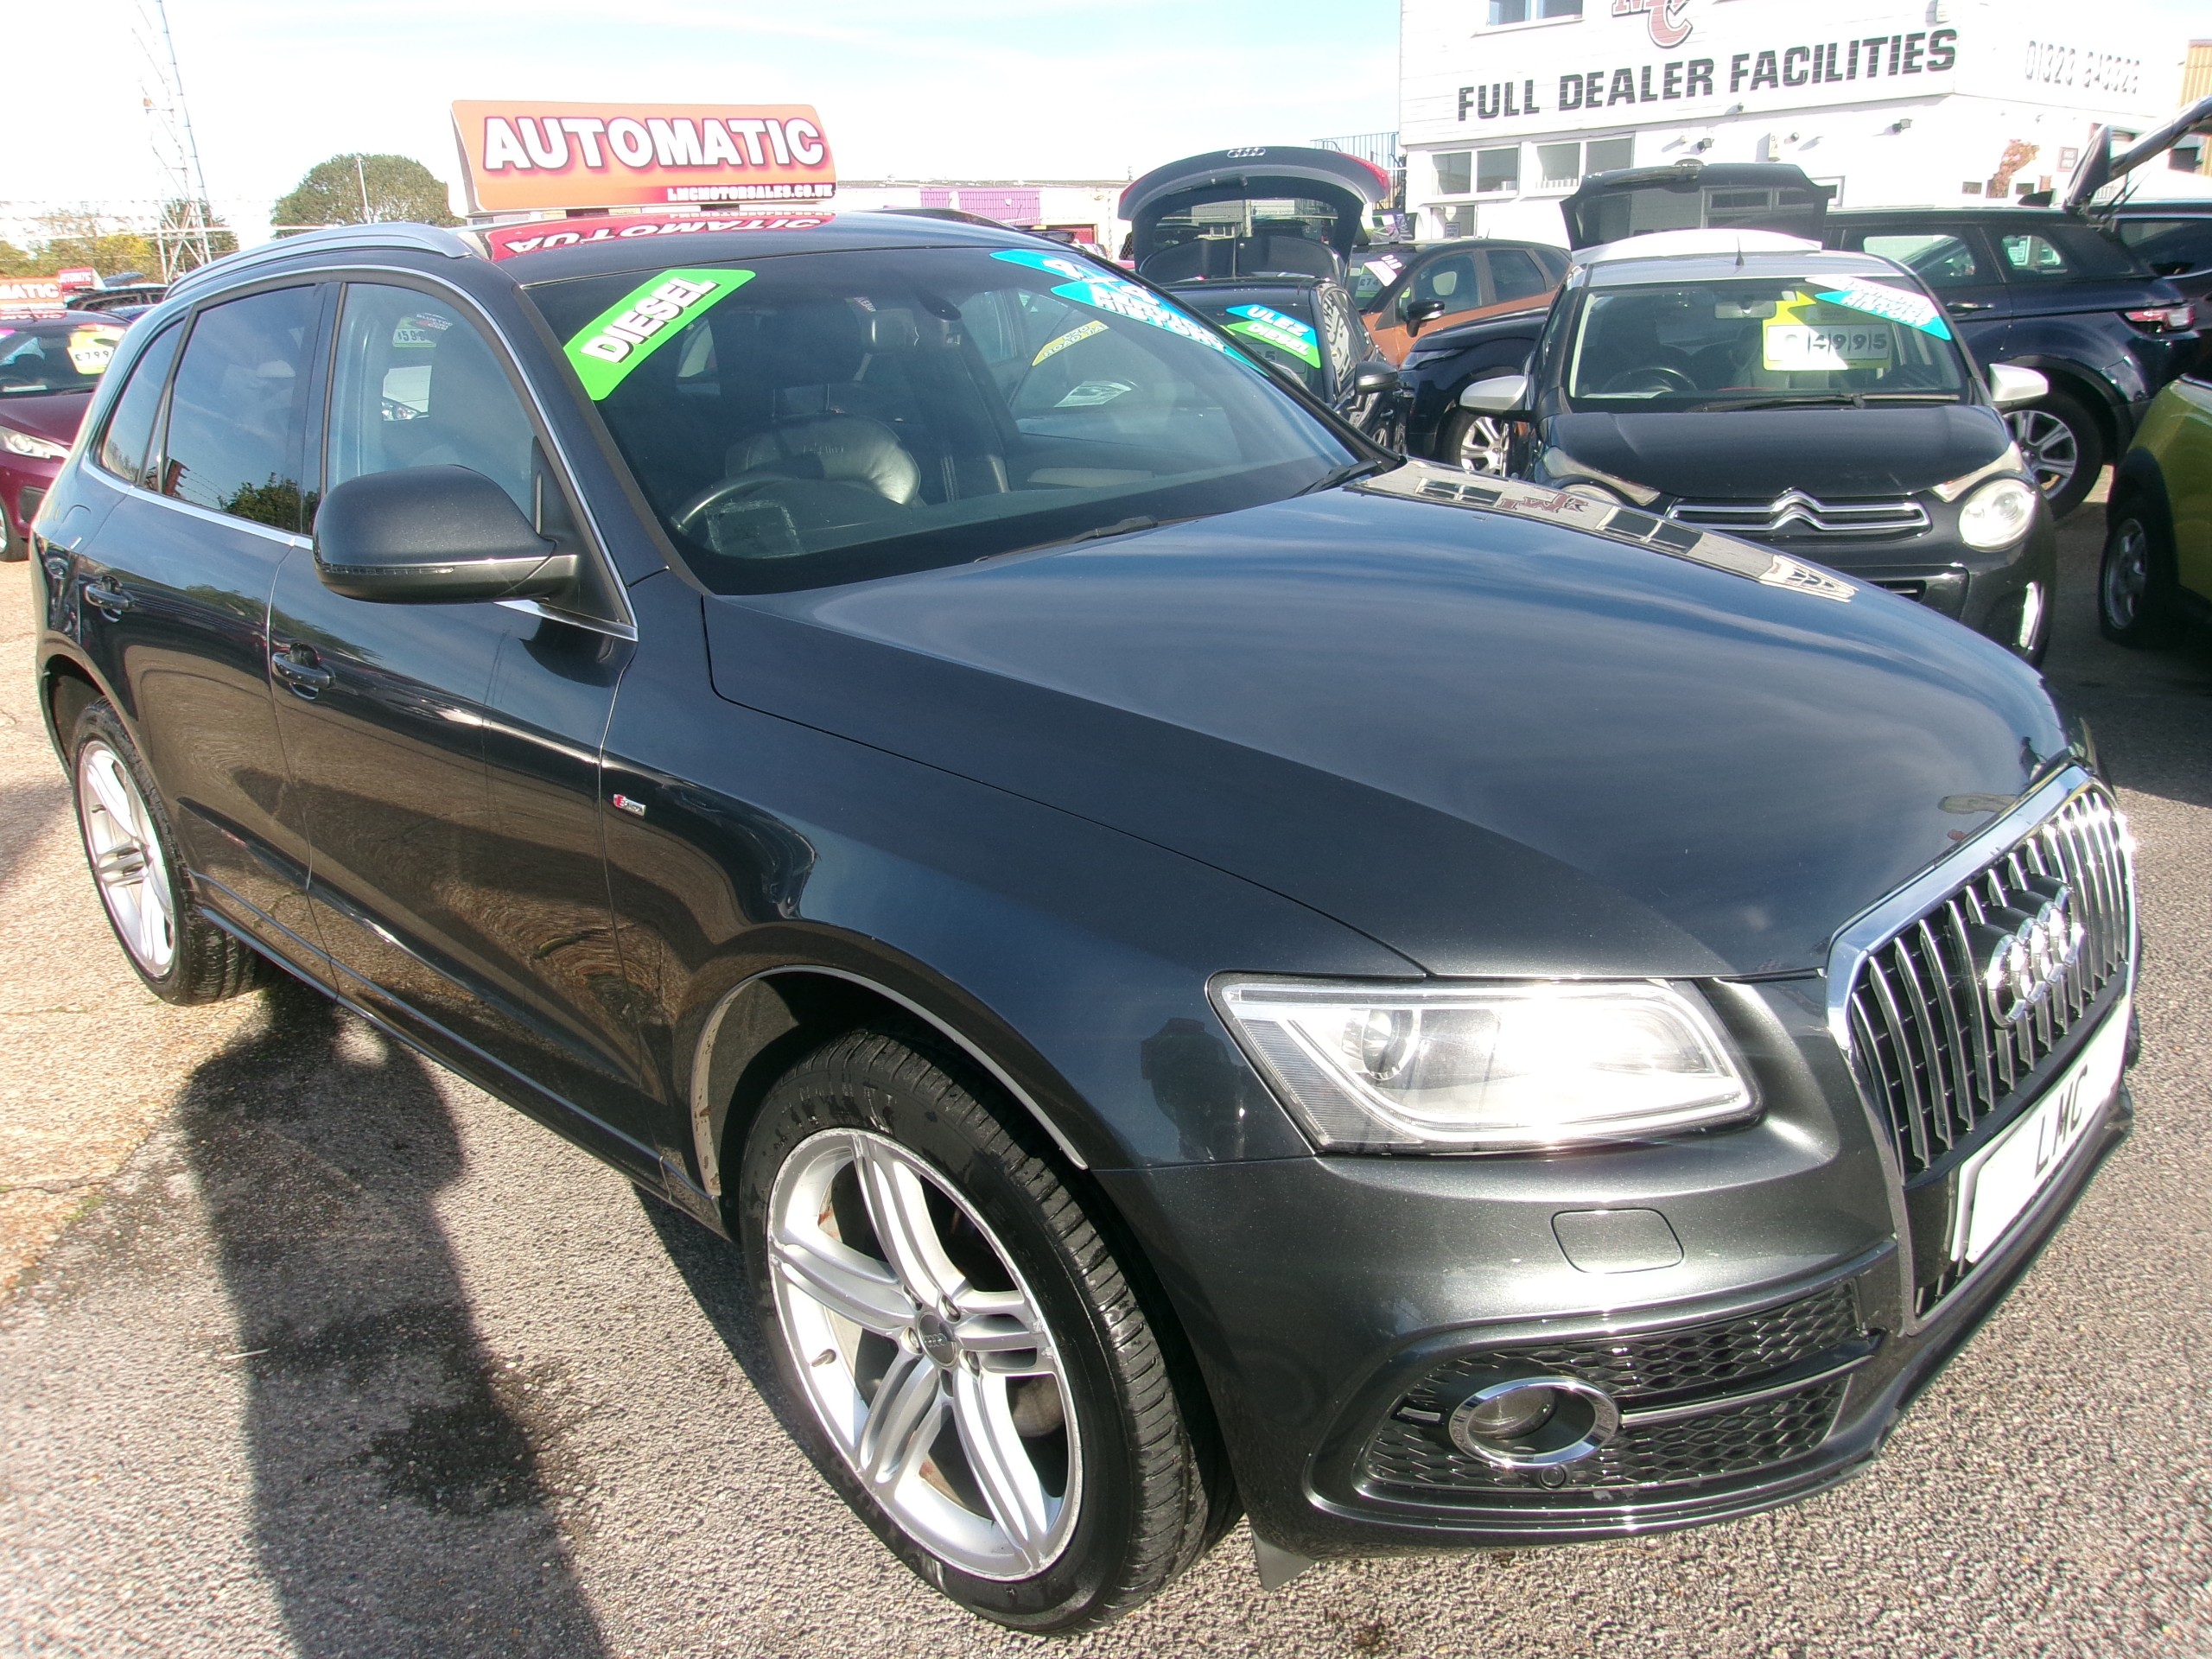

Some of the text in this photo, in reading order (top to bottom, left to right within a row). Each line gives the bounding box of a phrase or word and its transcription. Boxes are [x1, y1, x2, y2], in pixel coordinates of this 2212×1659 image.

[1458, 29, 1958, 122] FULL DEALER FACILITIES
[483, 116, 825, 171] AUTOMATIC
[666, 184, 834, 201] LMCMOTORSALES.CO.UK
[580, 277, 720, 364] DIESEL
[1247, 306, 1309, 337] ULEZ
[74, 350, 115, 361] £799
[1247, 322, 1308, 356] DIESEL
[1784, 333, 1888, 351] 4995
[2034, 1064, 2088, 1179] LMC
